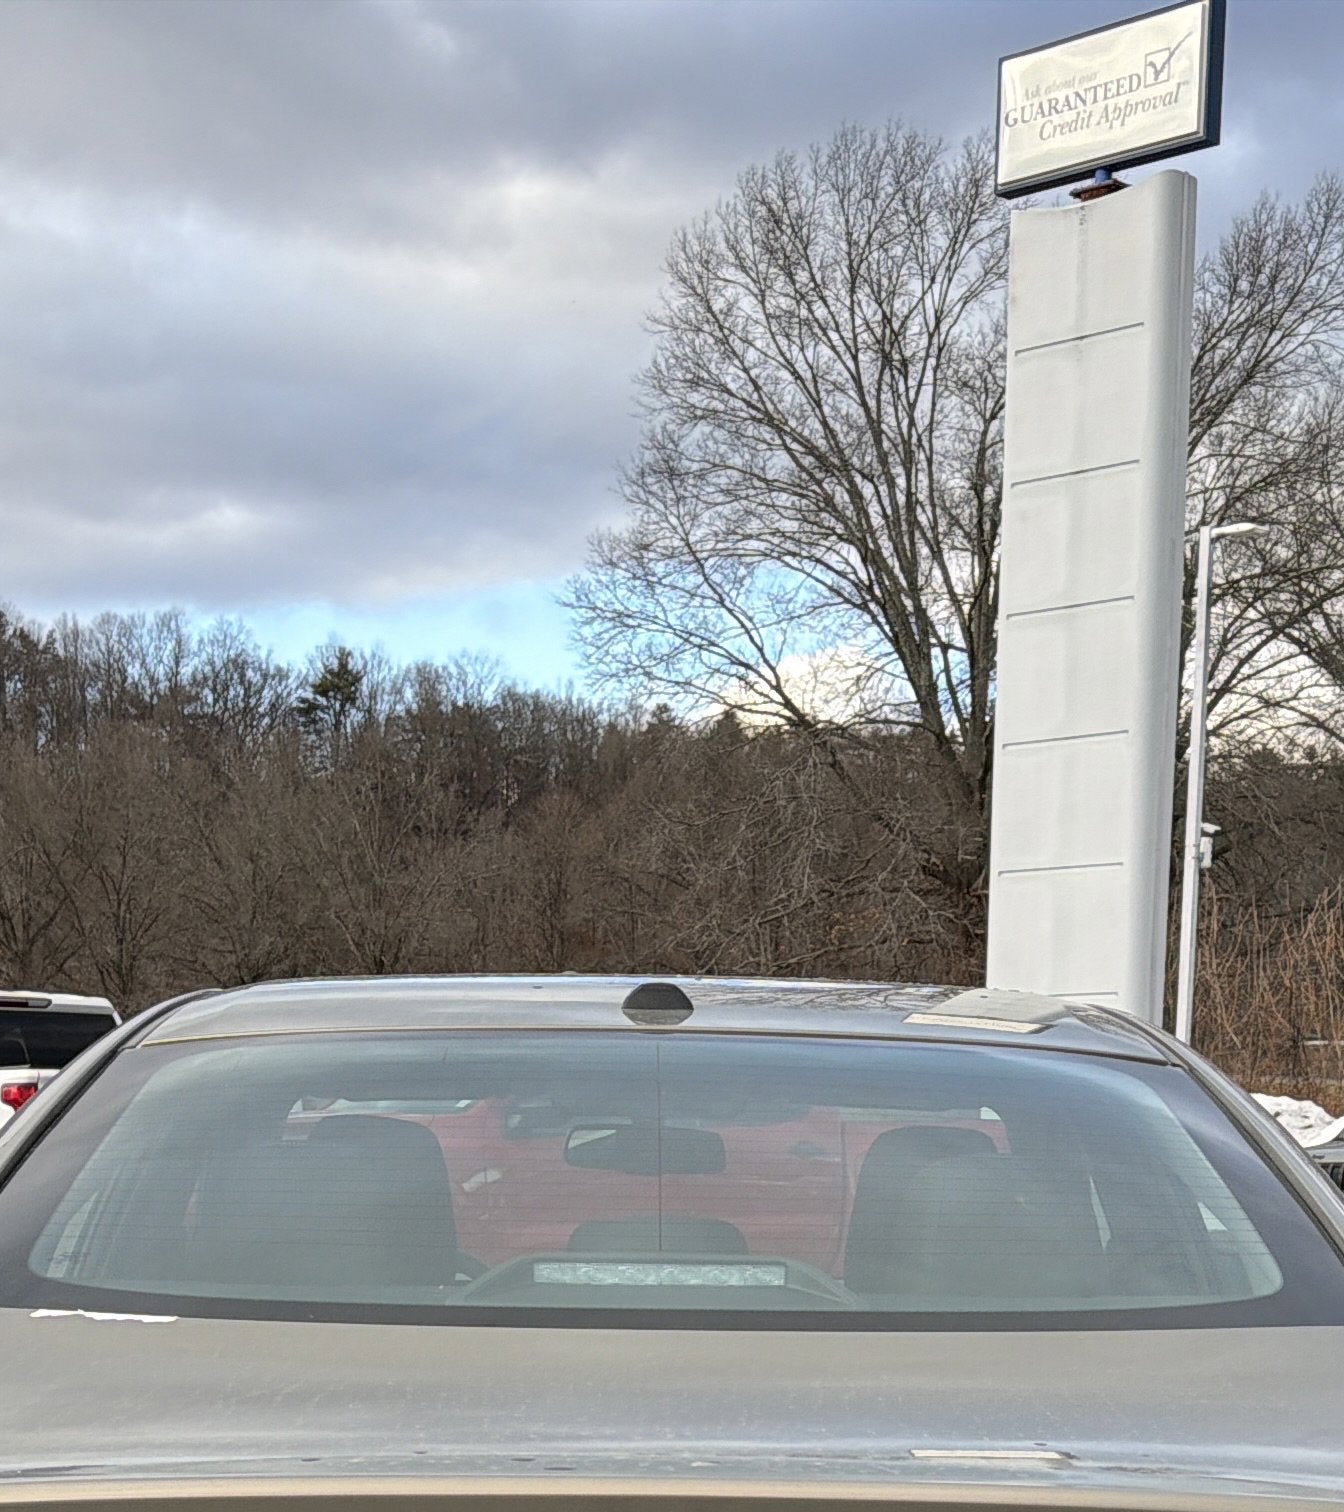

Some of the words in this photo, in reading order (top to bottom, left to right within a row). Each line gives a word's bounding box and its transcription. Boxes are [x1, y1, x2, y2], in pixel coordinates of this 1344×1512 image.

[1004, 73, 1142, 128] GUARANTEED
[1038, 110, 1093, 141] Credit
[1096, 82, 1181, 130] Approval
